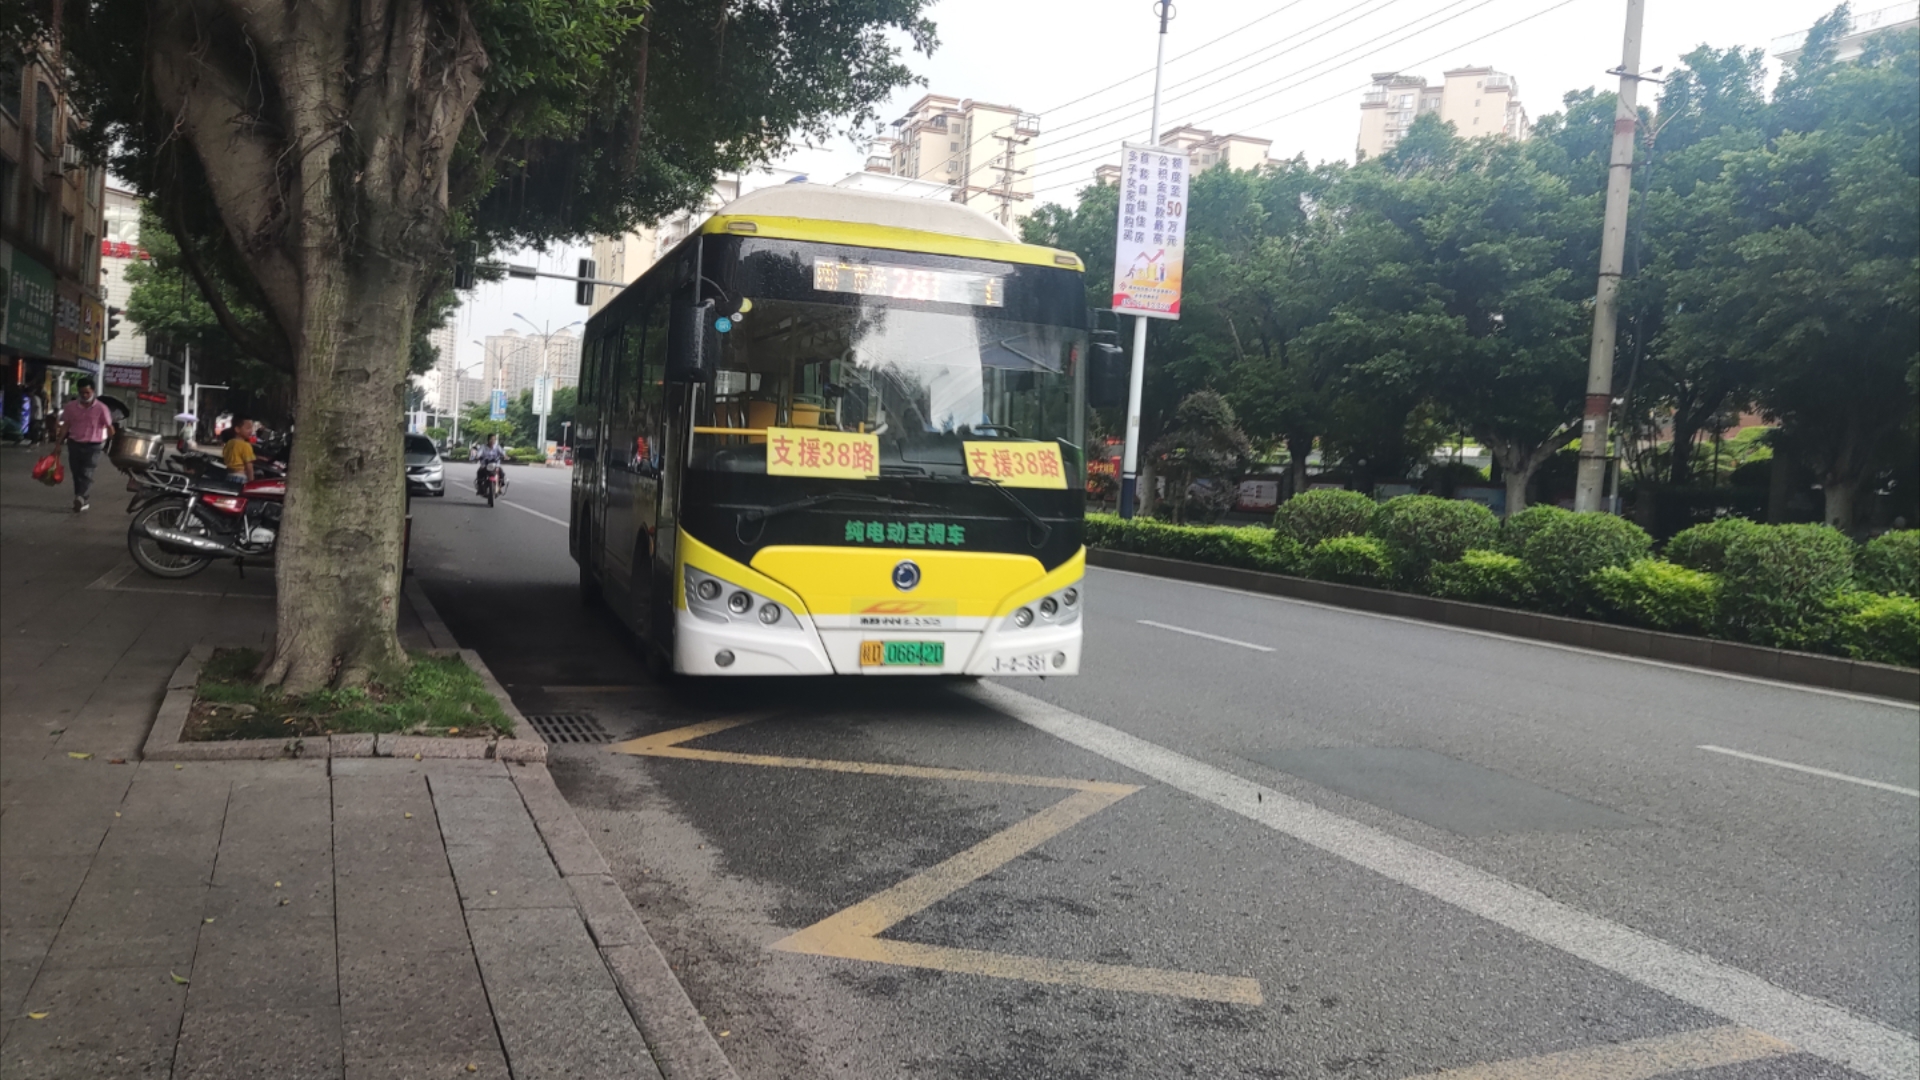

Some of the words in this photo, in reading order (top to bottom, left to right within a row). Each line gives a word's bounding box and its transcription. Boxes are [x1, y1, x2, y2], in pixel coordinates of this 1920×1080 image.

[1123, 150, 1137, 241] 多子女家庭购买
[1135, 152, 1149, 243] 首套自住住房
[1153, 155, 1168, 245] 公积金贷款最高
[1166, 157, 1182, 247] 额度至50万元
[772, 435, 874, 472] 支援38路
[969, 448, 1059, 478] 支援38路
[844, 519, 966, 546] 纯电动空调车
